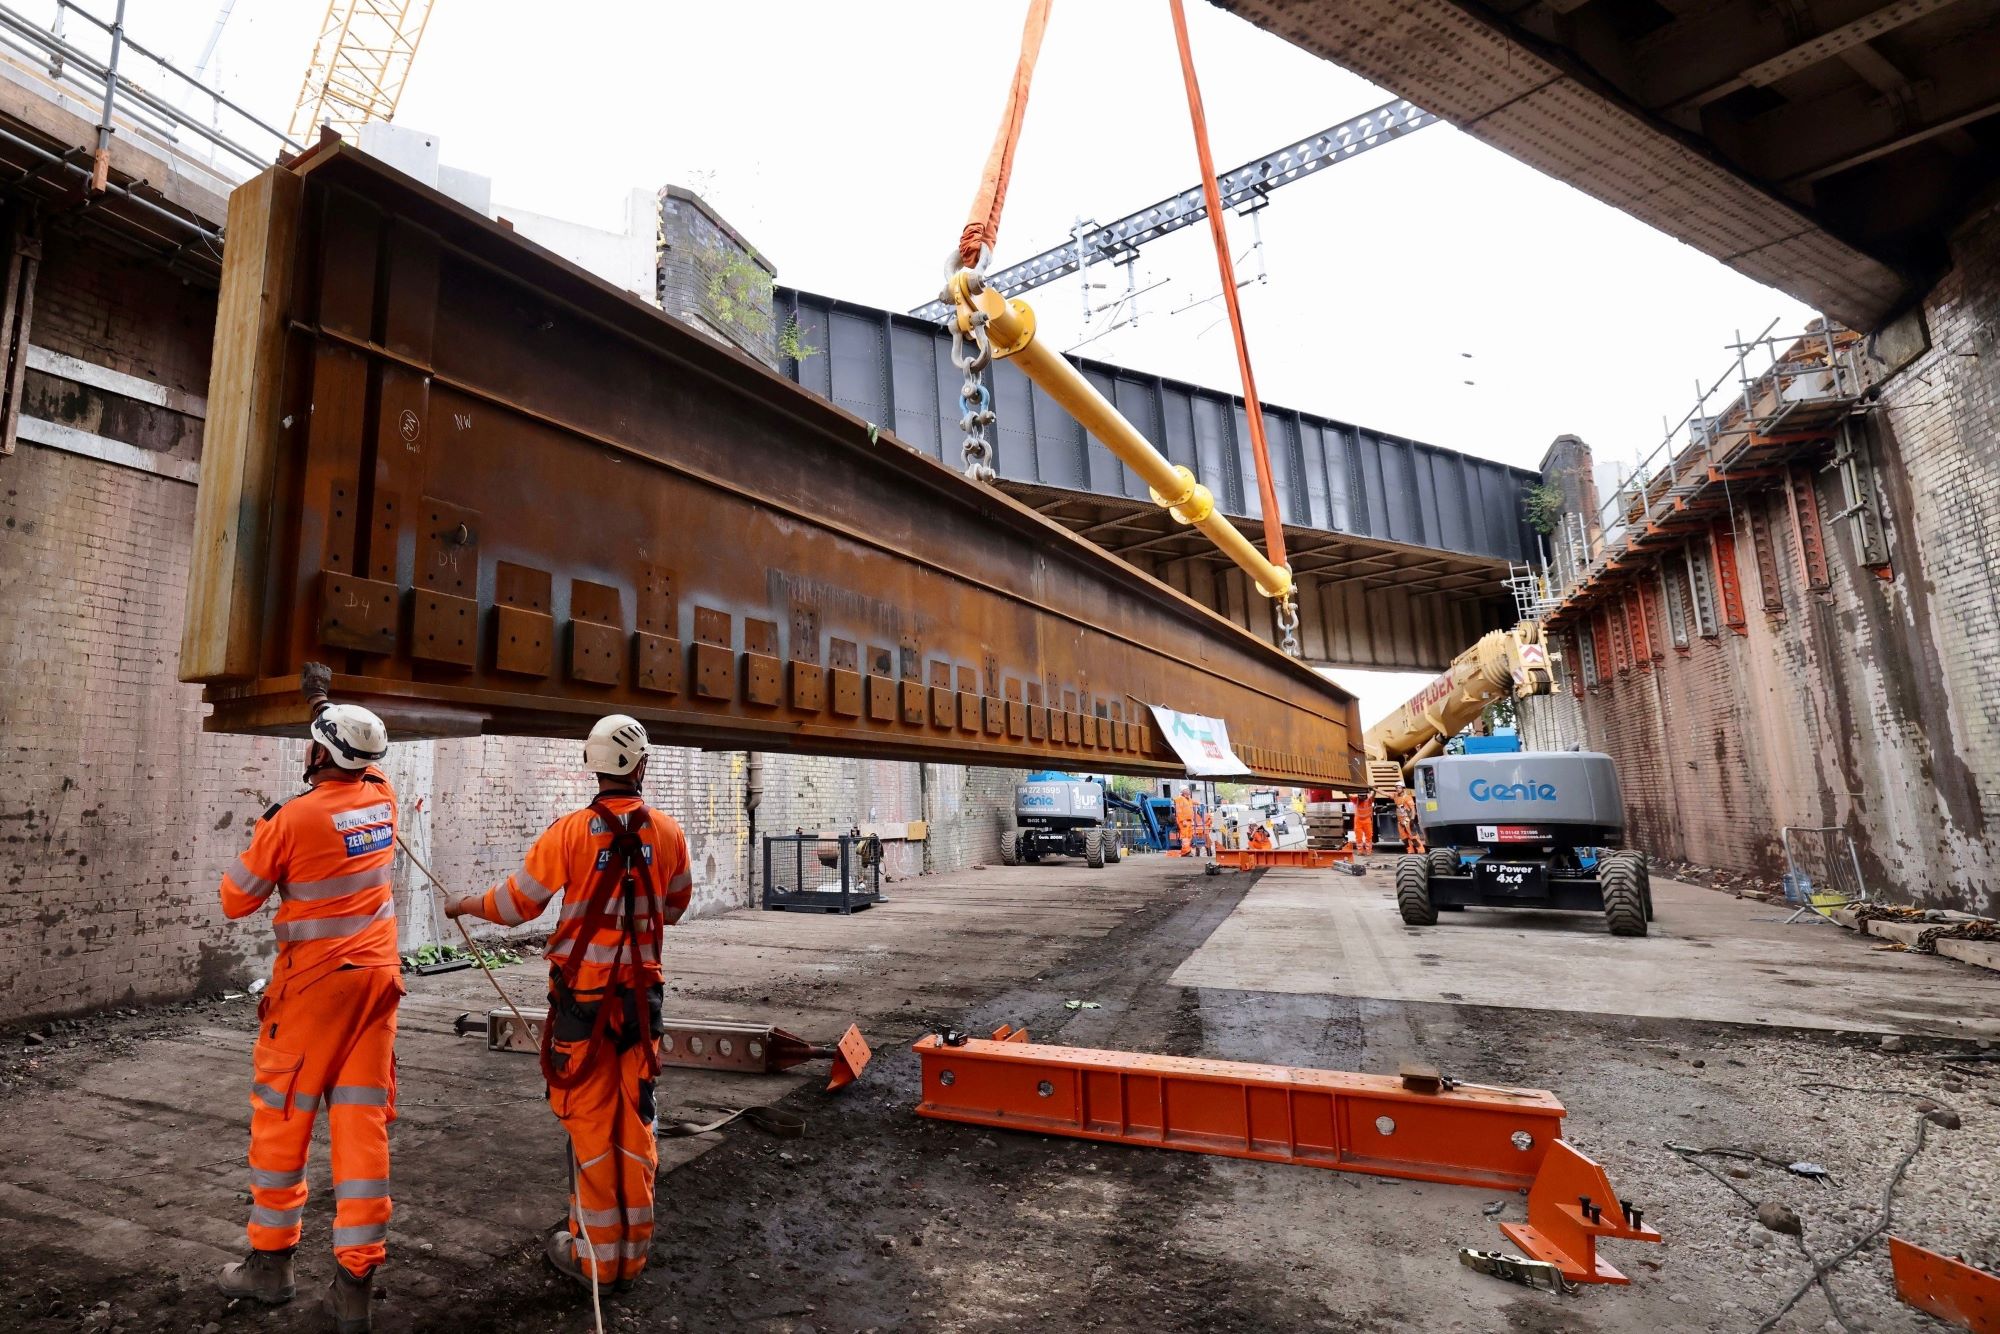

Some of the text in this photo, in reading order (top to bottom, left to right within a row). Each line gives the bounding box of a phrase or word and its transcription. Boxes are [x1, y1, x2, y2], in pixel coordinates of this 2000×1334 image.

[454, 413, 471, 430] NW
[437, 551, 458, 573] D4
[344, 592, 370, 617] D4
[1029, 786, 1041, 794] 272
[1469, 779, 1556, 801] Genie
[1022, 794, 1054, 806] Genie
[349, 814, 377, 826] HUGES
[379, 811, 389, 820] TD
[371, 826, 393, 842] HARM
[1486, 864, 1533, 873] IC Power
[1496, 873, 1524, 884] 4x4
